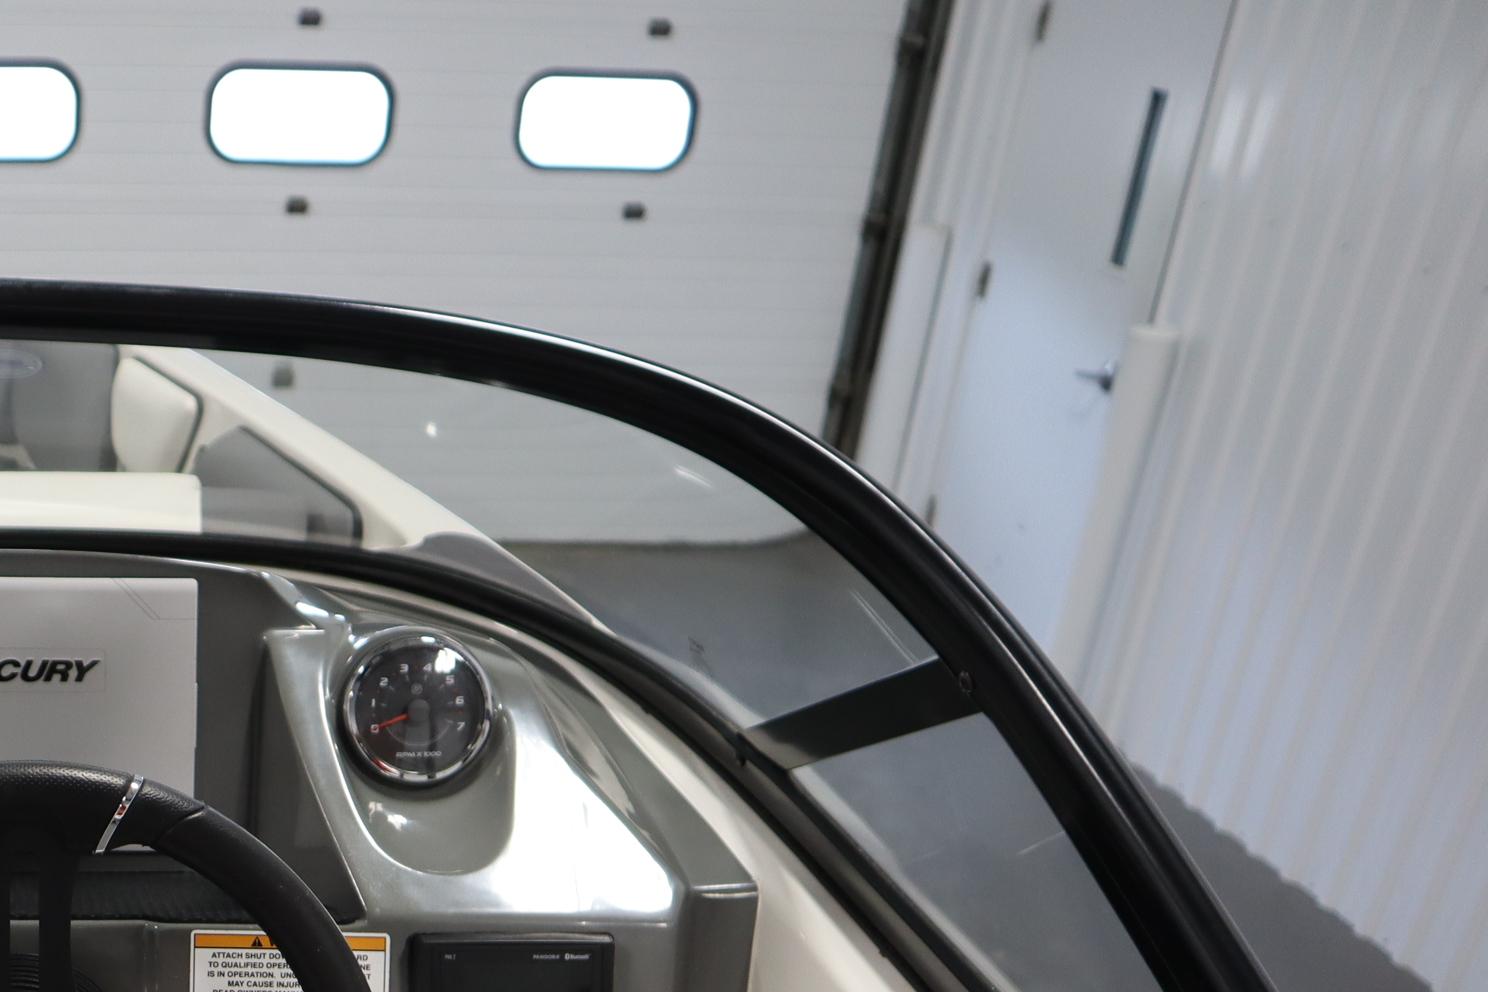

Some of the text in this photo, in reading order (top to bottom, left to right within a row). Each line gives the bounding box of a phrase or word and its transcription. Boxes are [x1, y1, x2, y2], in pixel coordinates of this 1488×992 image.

[400, 663, 409, 672] 3
[423, 664, 432, 672] 4
[379, 677, 388, 686] 2
[445, 676, 454, 684] 5
[371, 698, 375, 707] 1
[455, 696, 464, 705] 6
[457, 722, 465, 731] 7
[227, 971, 276, 979] OPERATION.
